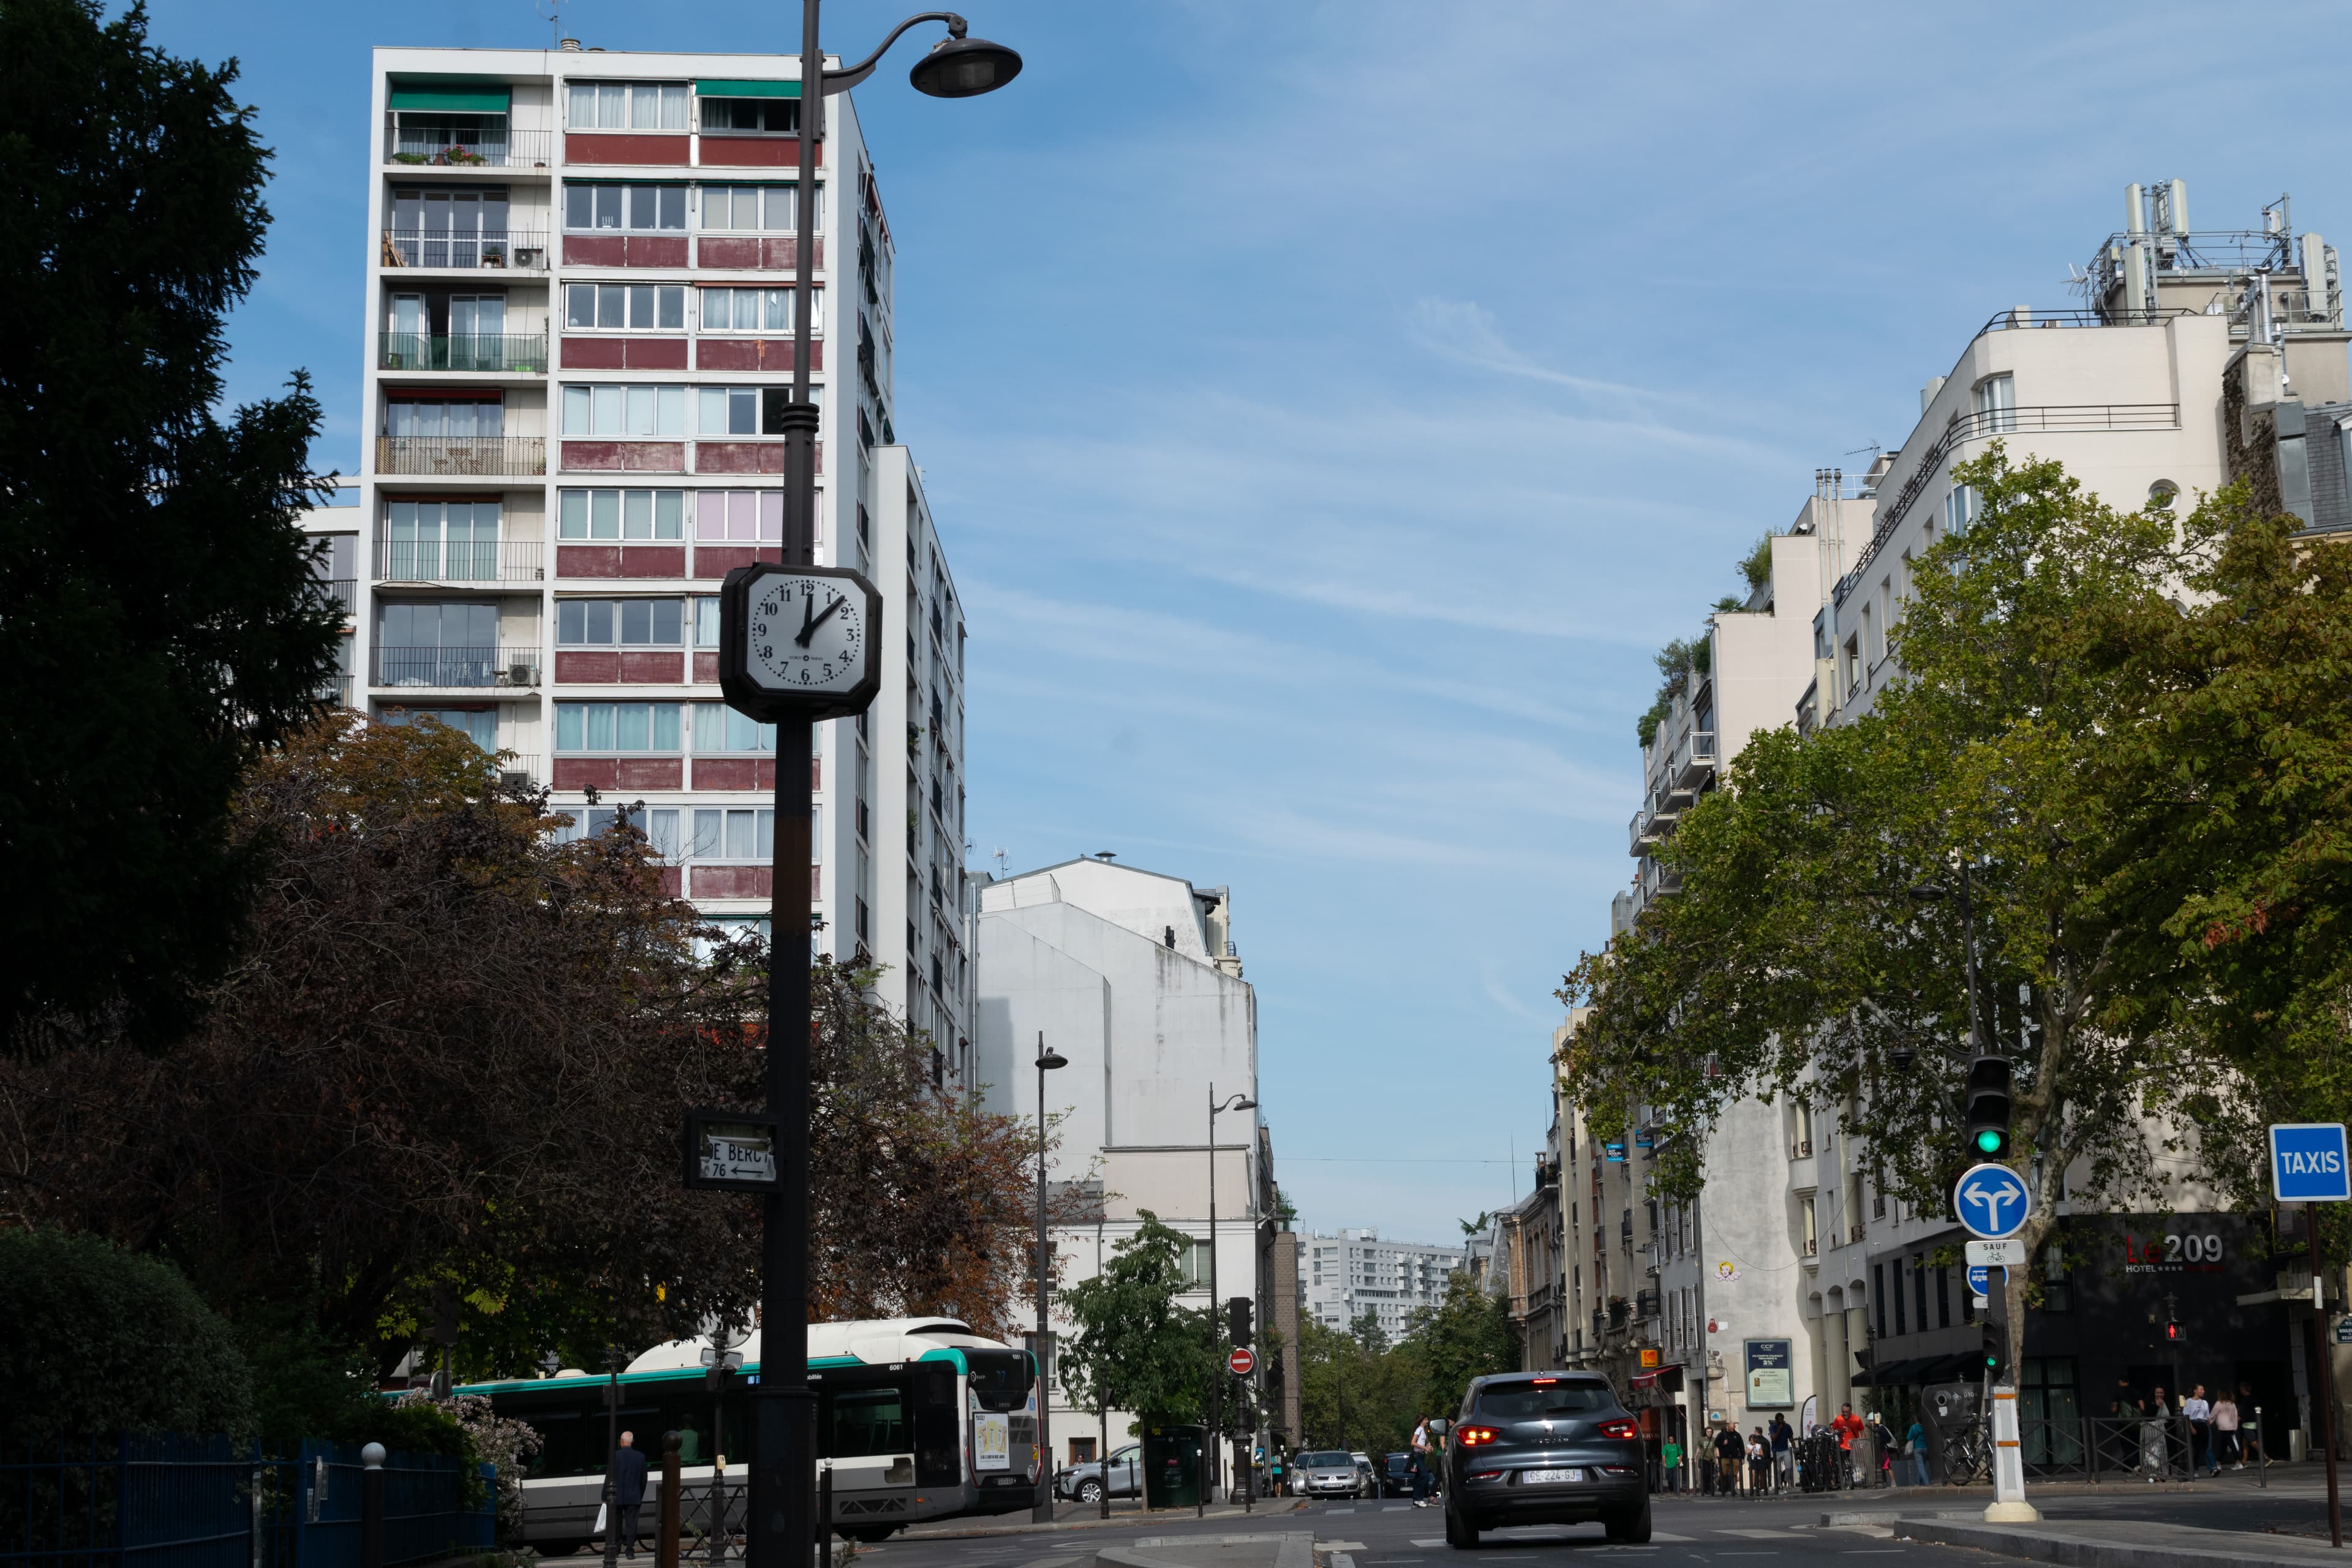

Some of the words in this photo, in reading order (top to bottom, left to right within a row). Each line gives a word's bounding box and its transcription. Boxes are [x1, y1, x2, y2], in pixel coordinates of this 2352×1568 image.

[780, 589, 791, 602] 11
[800, 584, 814, 596] 12
[826, 592, 832, 604] 1
[764, 603, 778, 616] 10
[840, 607, 849, 620] 2
[758, 624, 767, 636] 9
[846, 628, 855, 641] 3
[763, 646, 773, 658] 8
[839, 650, 849, 662] 4
[780, 662, 789, 674] 7
[823, 663, 832, 676] 5
[801, 669, 810, 681] 6
[2281, 1150, 2340, 1174] TAXIS
[712, 1164, 726, 1177] 76
[2127, 1235, 2160, 1264] Le
[2164, 1234, 2223, 1262] 209
[1028, 1466, 1035, 1477] 70
[1529, 1470, 1575, 1480] GE-224-GJ
